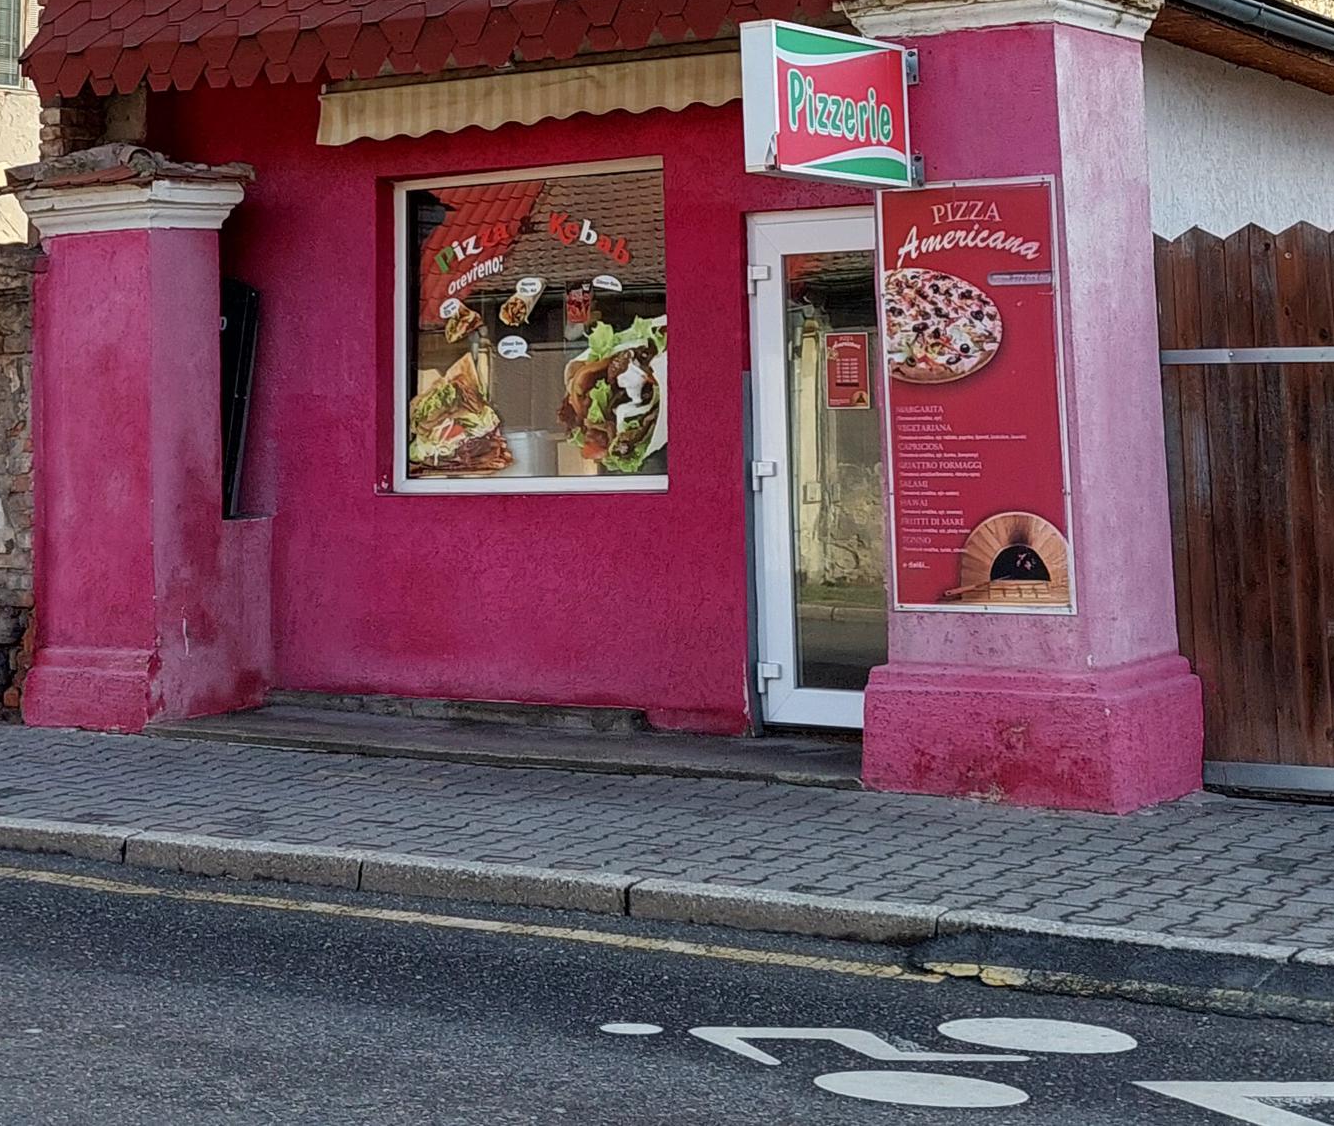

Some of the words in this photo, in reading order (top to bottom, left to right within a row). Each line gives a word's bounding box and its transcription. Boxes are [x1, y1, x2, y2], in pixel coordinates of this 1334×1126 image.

[788, 69, 892, 143] Pizzerie
[931, 201, 1002, 225] PIZZA
[434, 224, 509, 272] Pizza
[549, 212, 630, 264] Kebab
[897, 224, 1041, 268] Americana
[931, 518, 940, 526] DI
